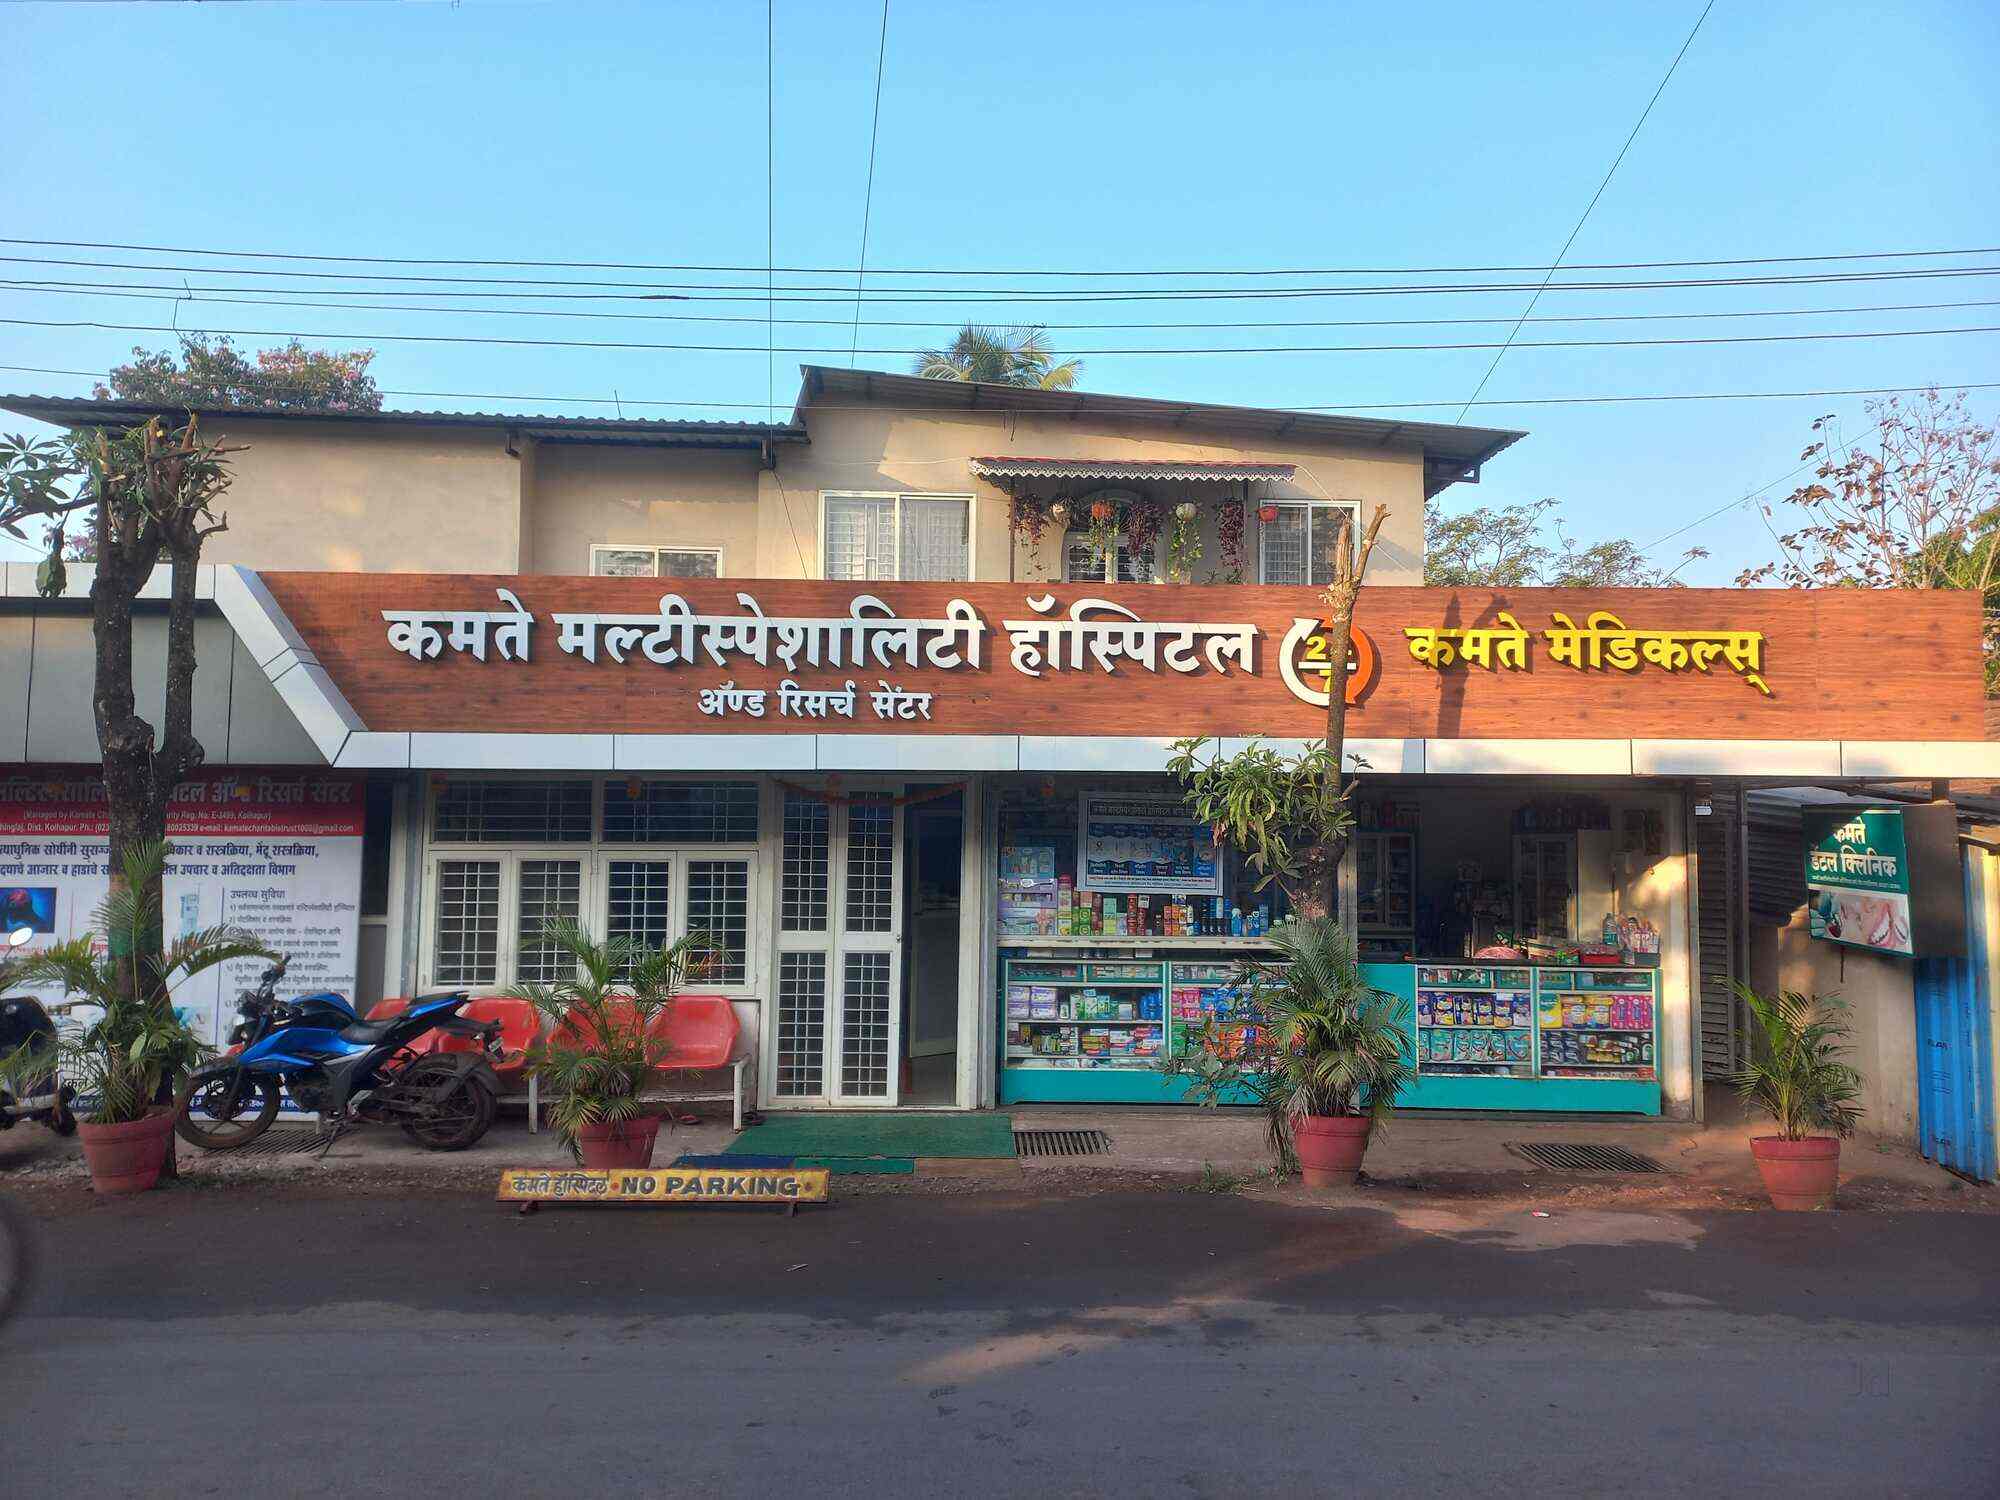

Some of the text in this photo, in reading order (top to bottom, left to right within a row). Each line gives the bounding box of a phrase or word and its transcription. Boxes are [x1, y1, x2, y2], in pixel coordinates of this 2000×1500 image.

[382, 589, 1259, 676] कमते मल्टीस्पेशालिटी हॉस्पिटल
[1404, 611, 1532, 668] कमते
[776, 679, 857, 718] रिसर्च
[869, 679, 932, 720] सेंटर
[621, 1176, 800, 1197] NO PARKING
